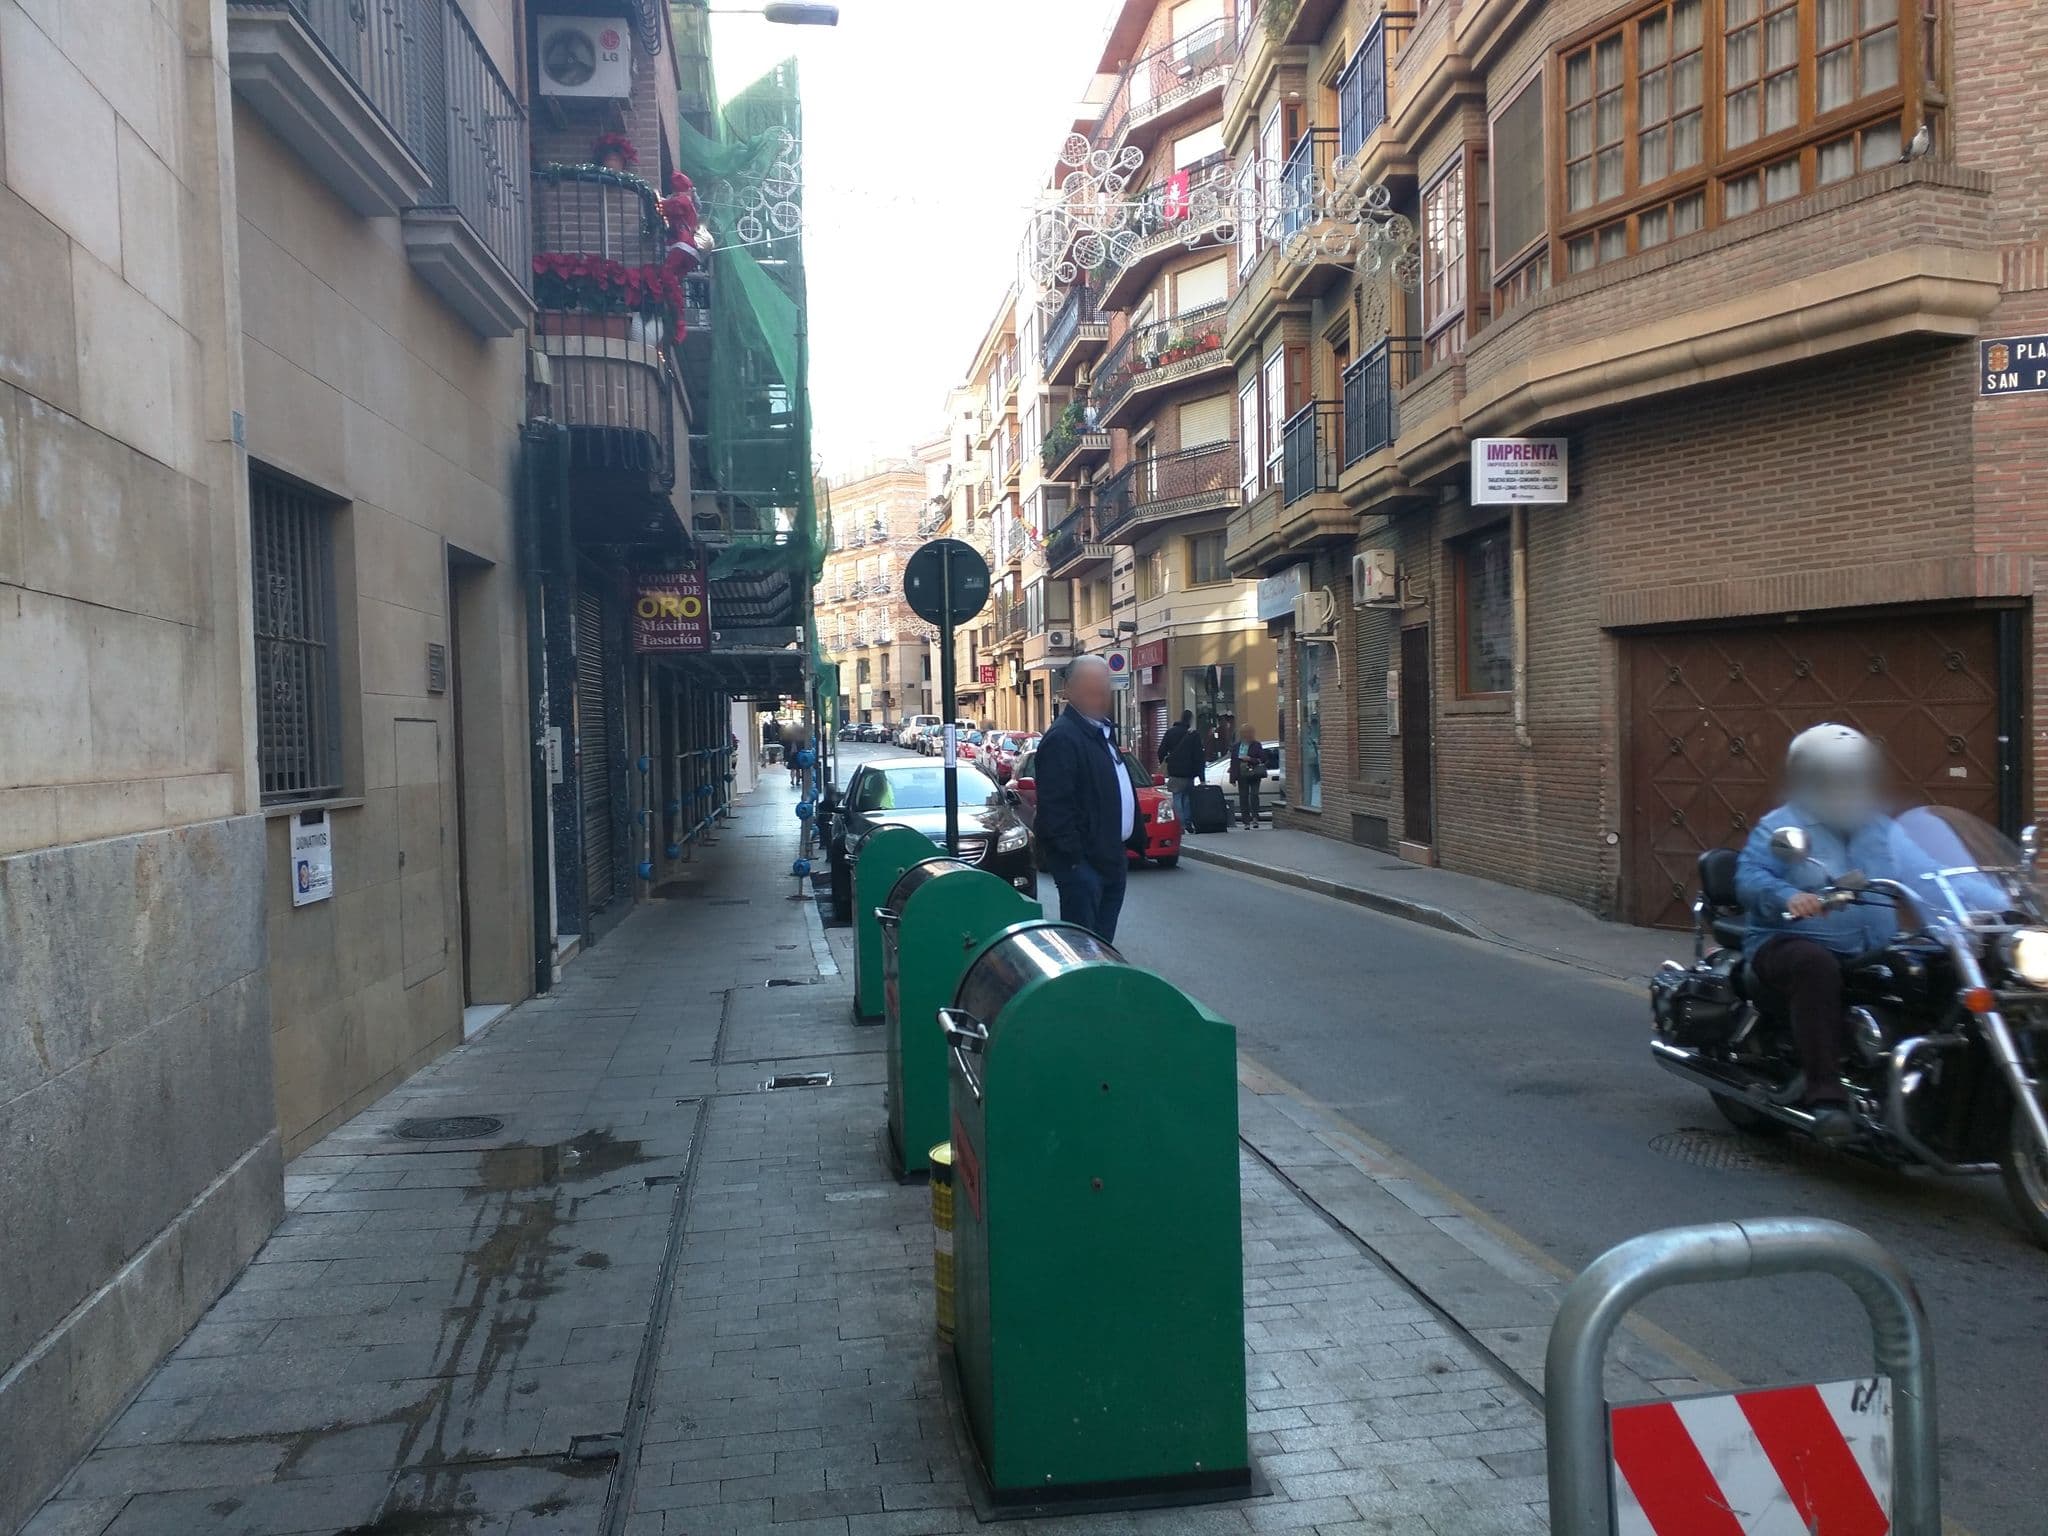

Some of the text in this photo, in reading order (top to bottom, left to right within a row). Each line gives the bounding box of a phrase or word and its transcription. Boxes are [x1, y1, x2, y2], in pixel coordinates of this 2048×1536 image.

[602, 52, 619, 62] LG
[2017, 342, 2048, 360] PLA
[1987, 372, 2019, 390] SAN
[1487, 443, 1559, 461] IMPRENTA
[639, 573, 698, 584] COMPRA
[682, 585, 702, 596] DE
[638, 595, 702, 618] ORO
[640, 619, 700, 632] Máxima
[641, 633, 702, 646] Tasación
